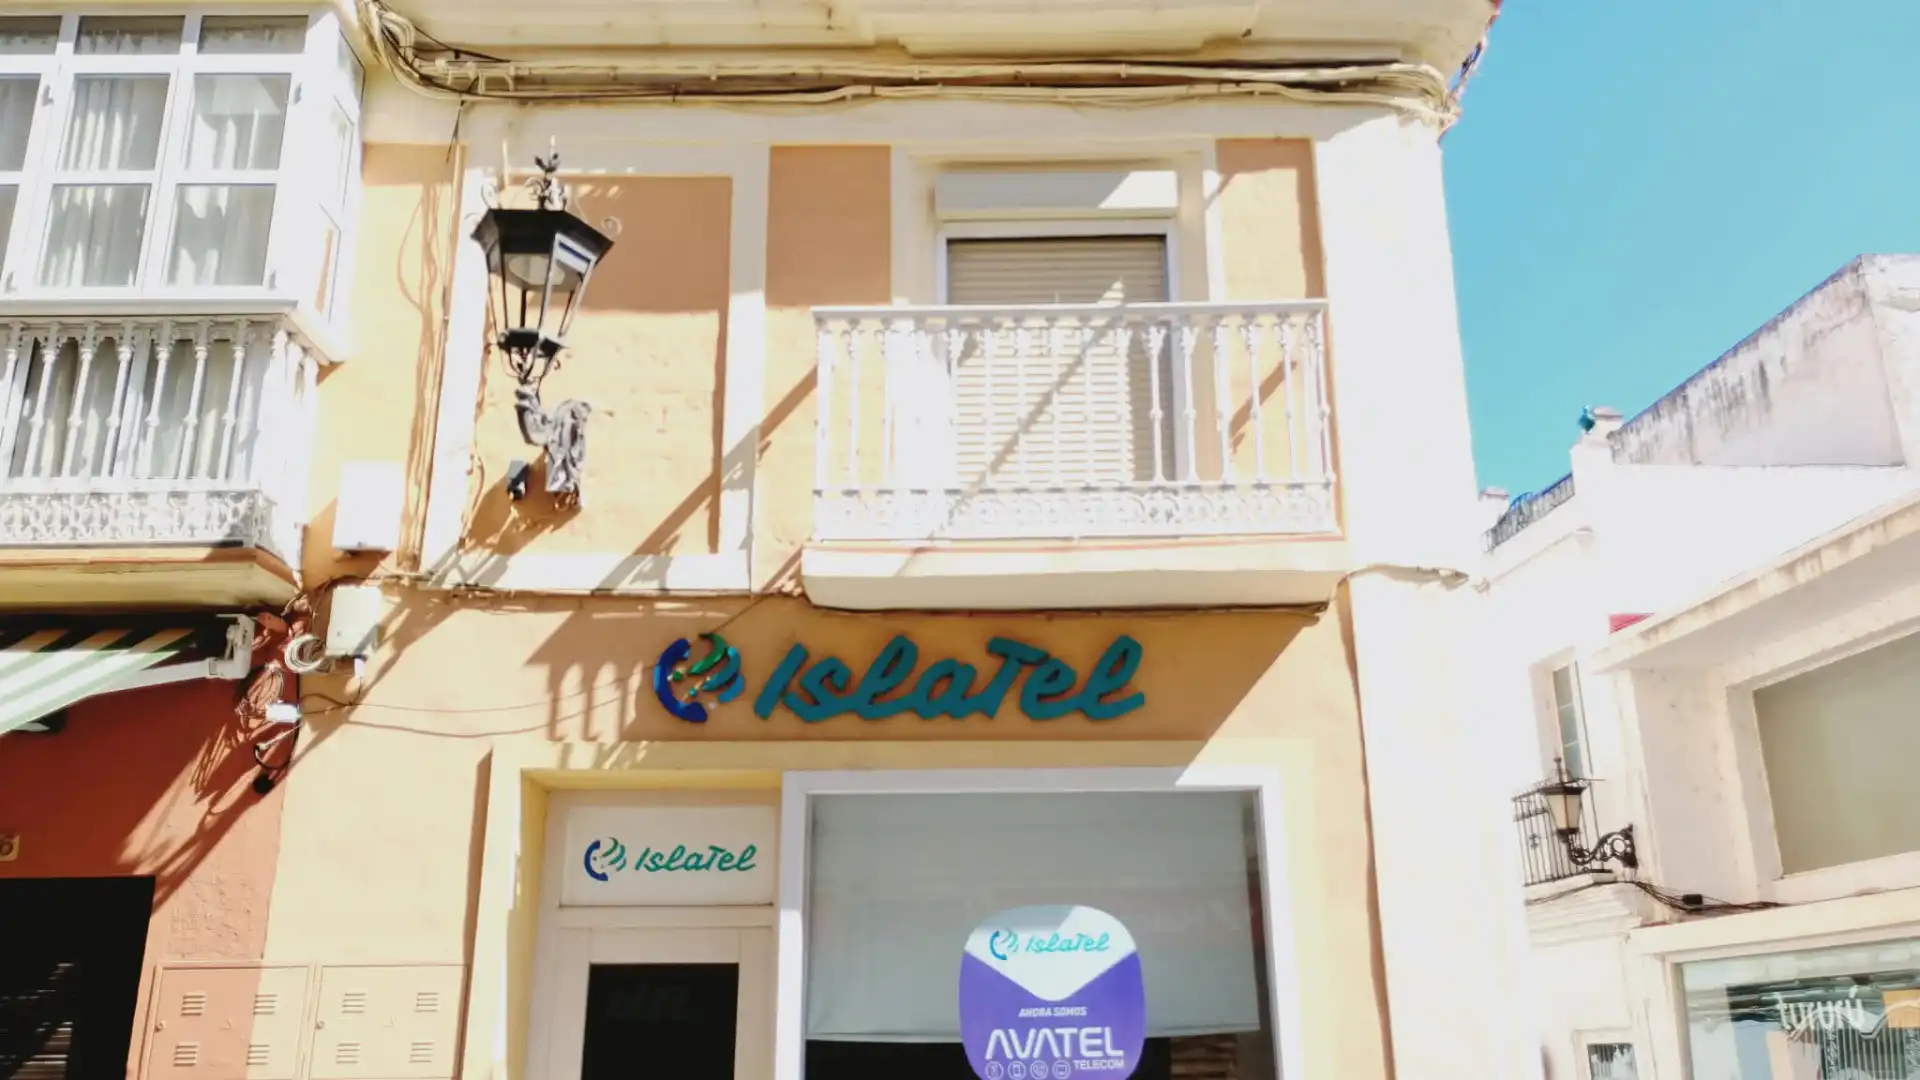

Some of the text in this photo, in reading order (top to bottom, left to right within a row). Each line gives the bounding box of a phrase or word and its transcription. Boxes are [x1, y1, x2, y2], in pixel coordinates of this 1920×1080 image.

[1053, 1006, 1088, 1018] SOMOS
[985, 1026, 1125, 1060] AVATEL
[1073, 1059, 1126, 1071] TELECOM
